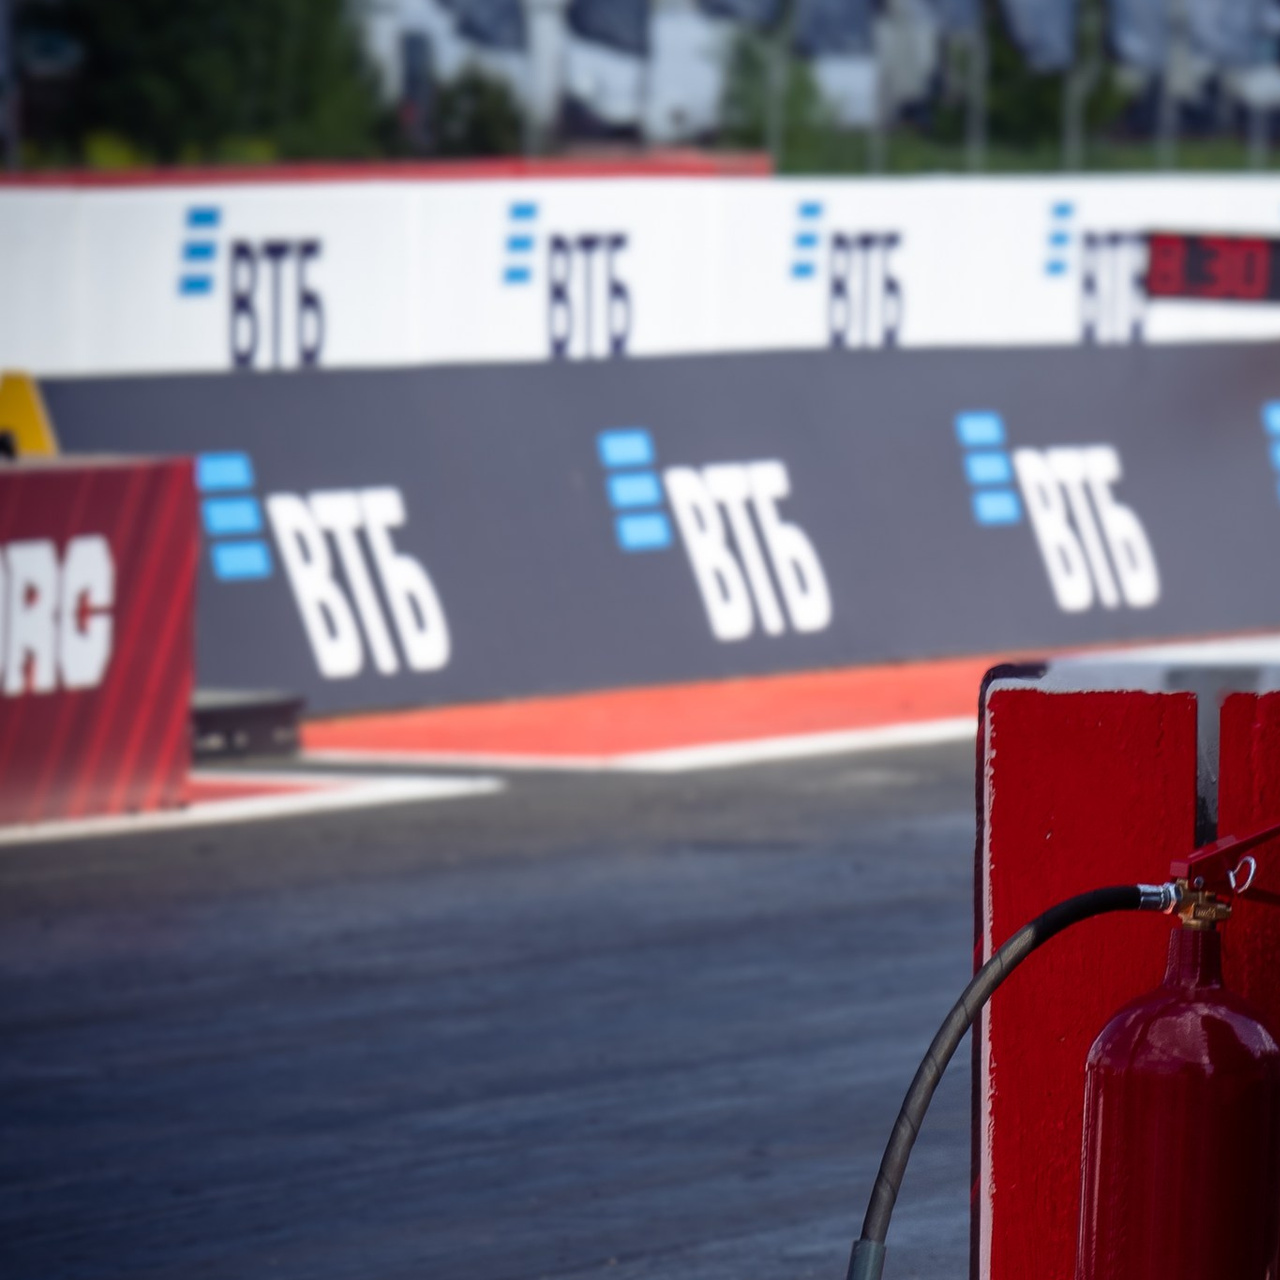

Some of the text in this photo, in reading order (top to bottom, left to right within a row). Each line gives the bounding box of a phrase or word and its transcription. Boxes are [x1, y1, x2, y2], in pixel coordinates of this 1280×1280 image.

[230, 239, 324, 369] ВТБ
[548, 233, 632, 360] ВТБ
[832, 232, 902, 348] ВТБ
[266, 486, 450, 678] ВТБ
[664, 460, 832, 641] ВТБ
[1012, 445, 1160, 612] ВТБ
[0, 535, 115, 696] RC
